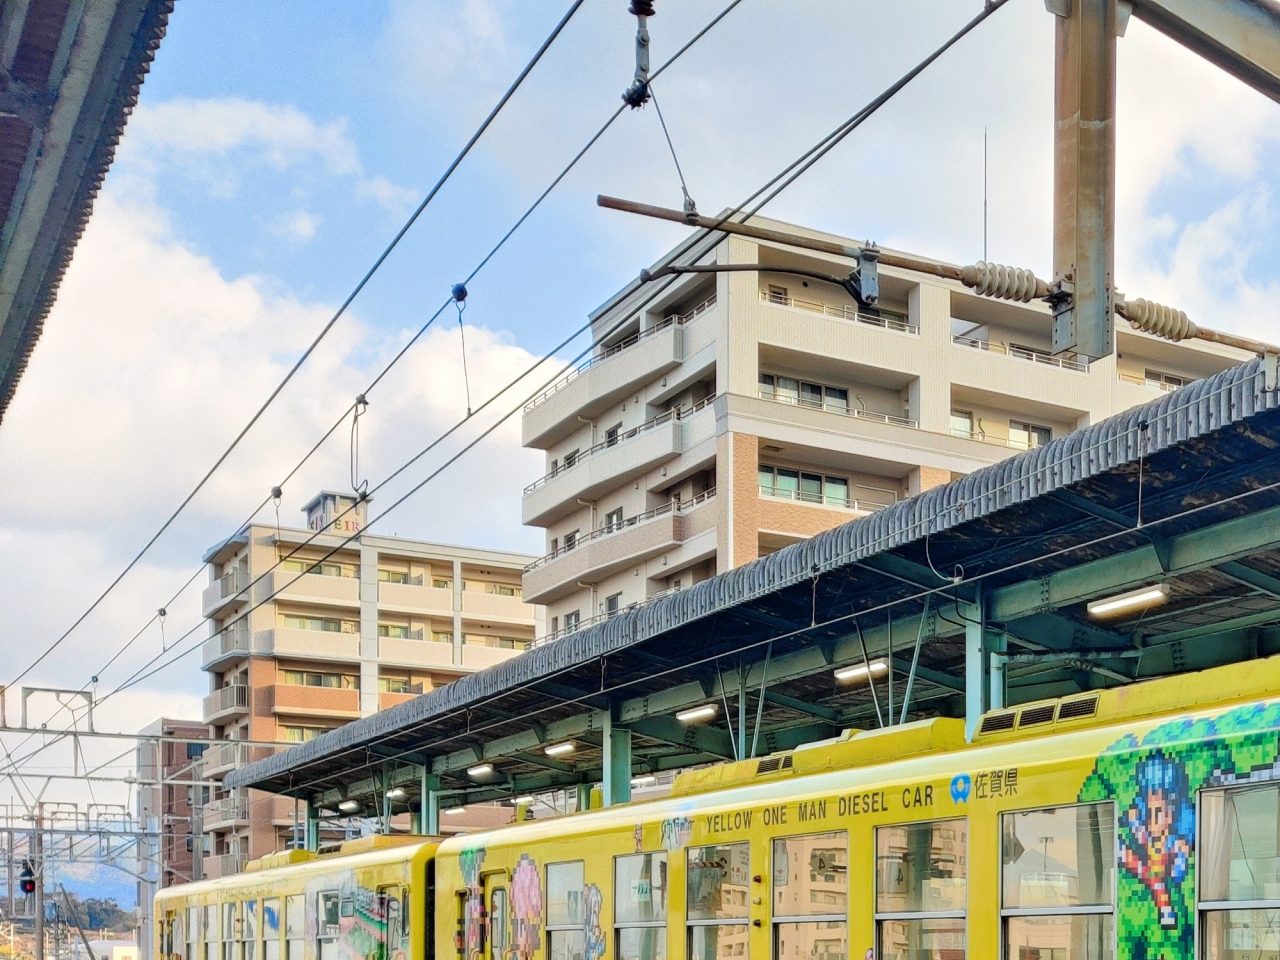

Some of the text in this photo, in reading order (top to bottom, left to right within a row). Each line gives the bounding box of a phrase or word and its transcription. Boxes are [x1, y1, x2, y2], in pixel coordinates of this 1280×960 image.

[974, 768, 1018, 799] 佐賀県
[707, 810, 752, 833] YELLOW
[763, 805, 787, 825] ONE
[799, 801, 826, 822] MAN
[838, 791, 888, 817] DIESEL
[902, 784, 933, 809] CAR
